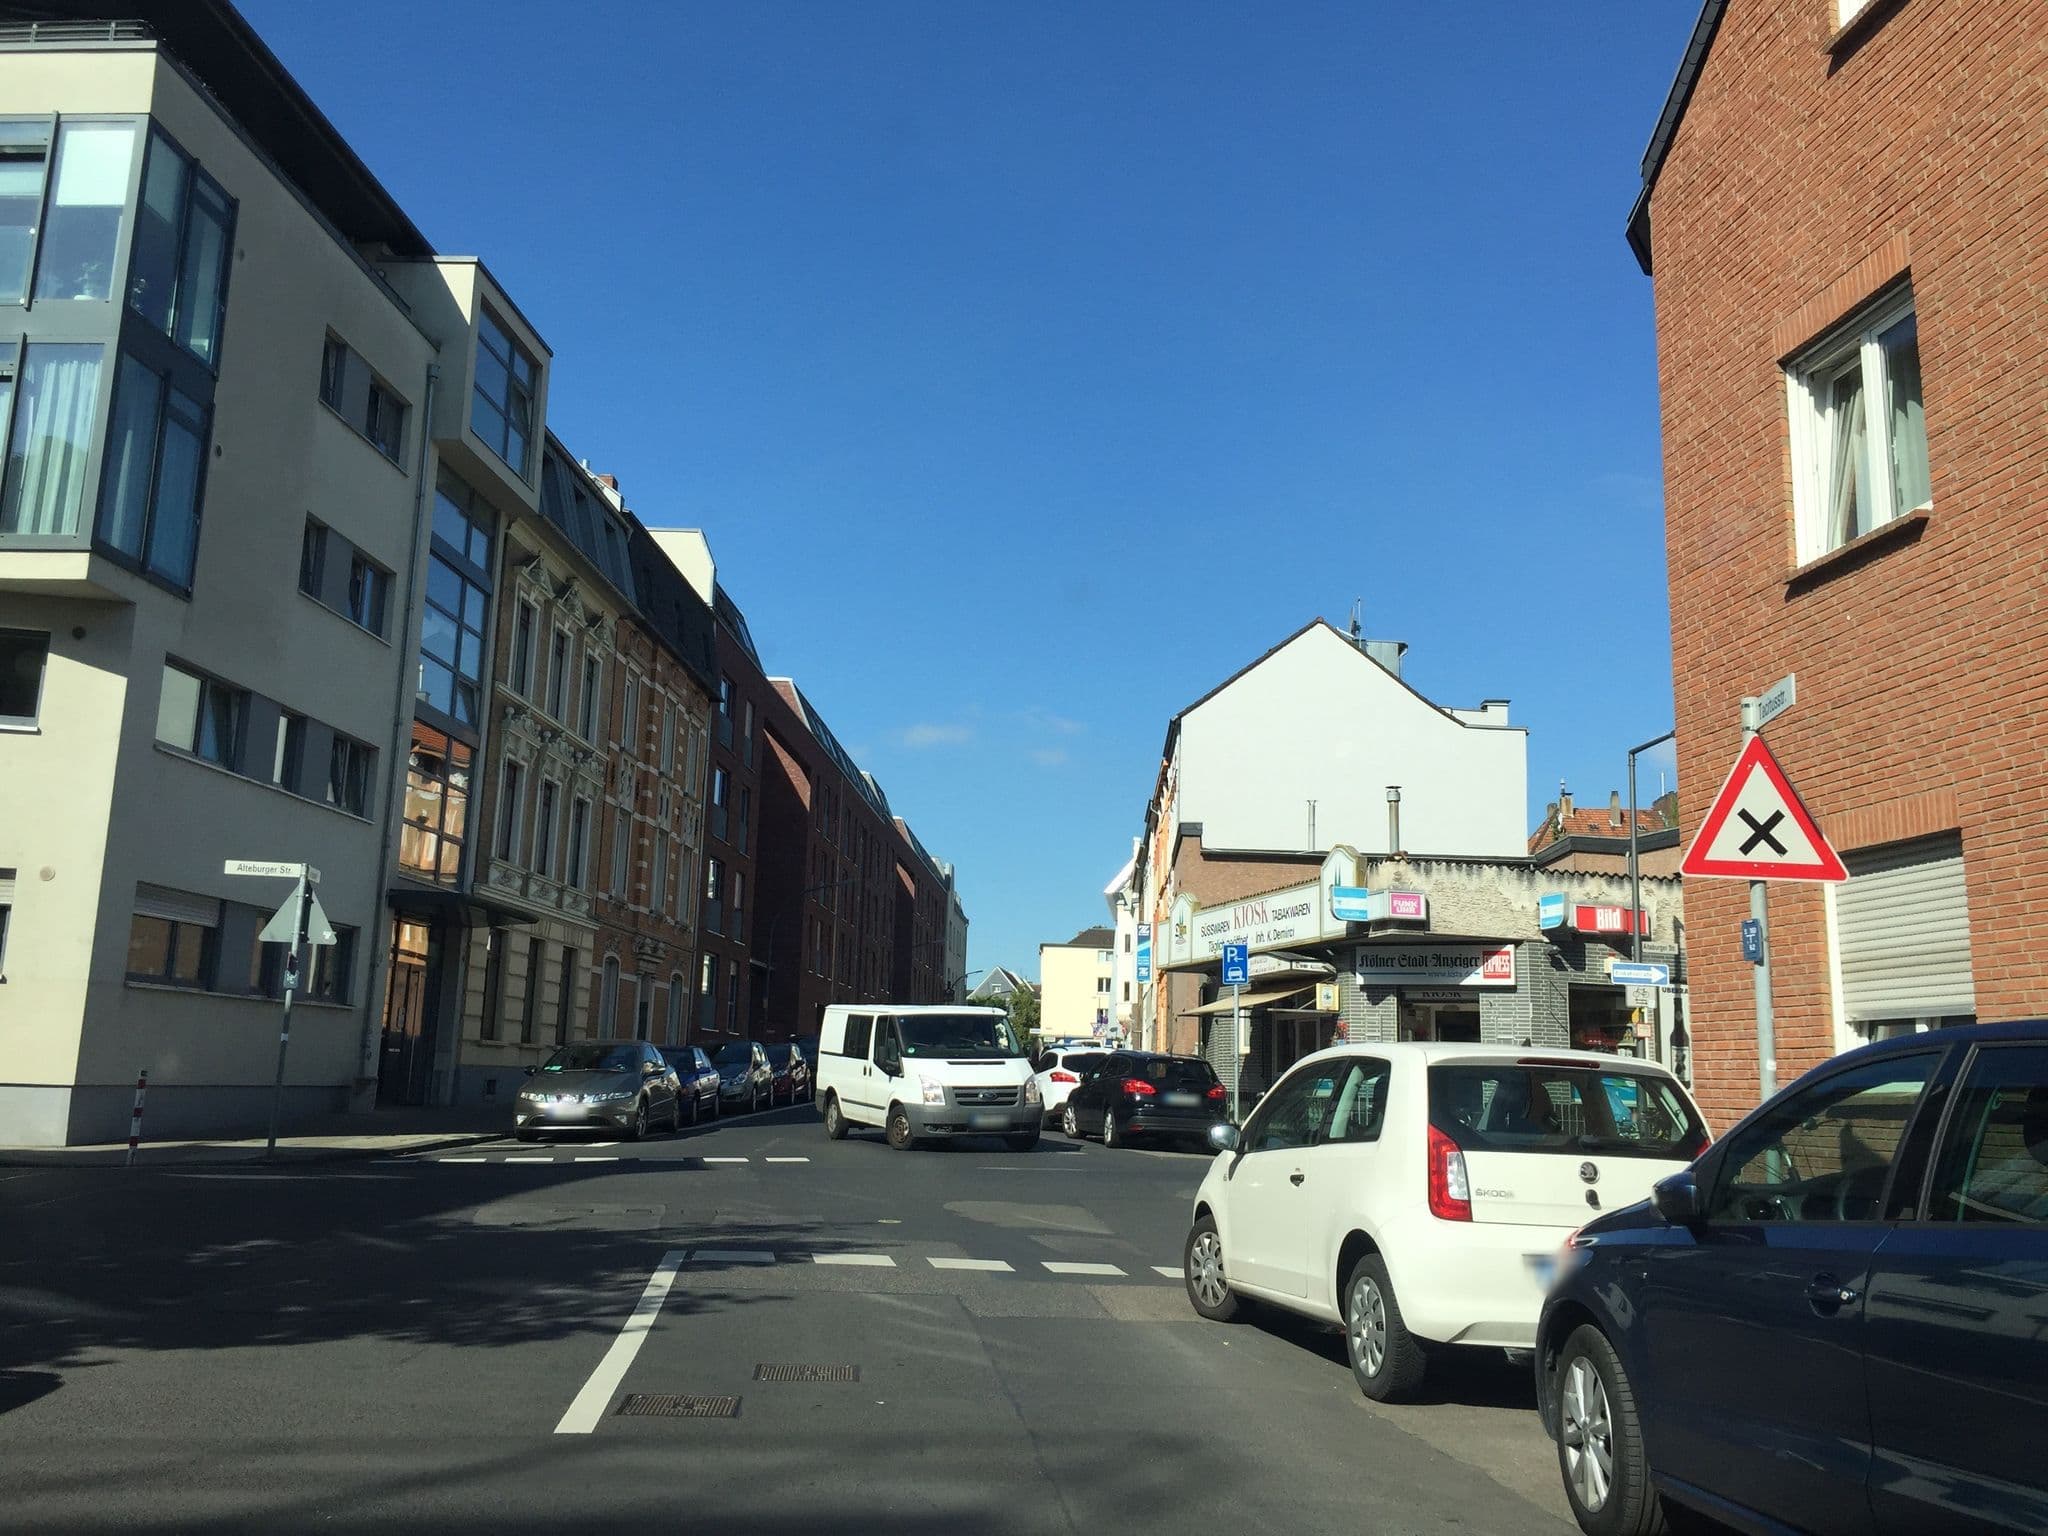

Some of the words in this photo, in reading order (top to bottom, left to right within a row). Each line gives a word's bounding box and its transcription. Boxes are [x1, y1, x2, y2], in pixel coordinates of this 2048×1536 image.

[236, 863, 277, 875] Alteburger
[1393, 899, 1418, 908] FUNK
[1396, 906, 1417, 914] UHR
[1233, 900, 1269, 930] KIOSK
[1271, 902, 1311, 921] TABAKWAREN
[1596, 907, 1621, 929] Bild
[1227, 947, 1238, 963] P
[1359, 952, 1396, 968] Kölner
[1484, 955, 1510, 972] EXPRESS
